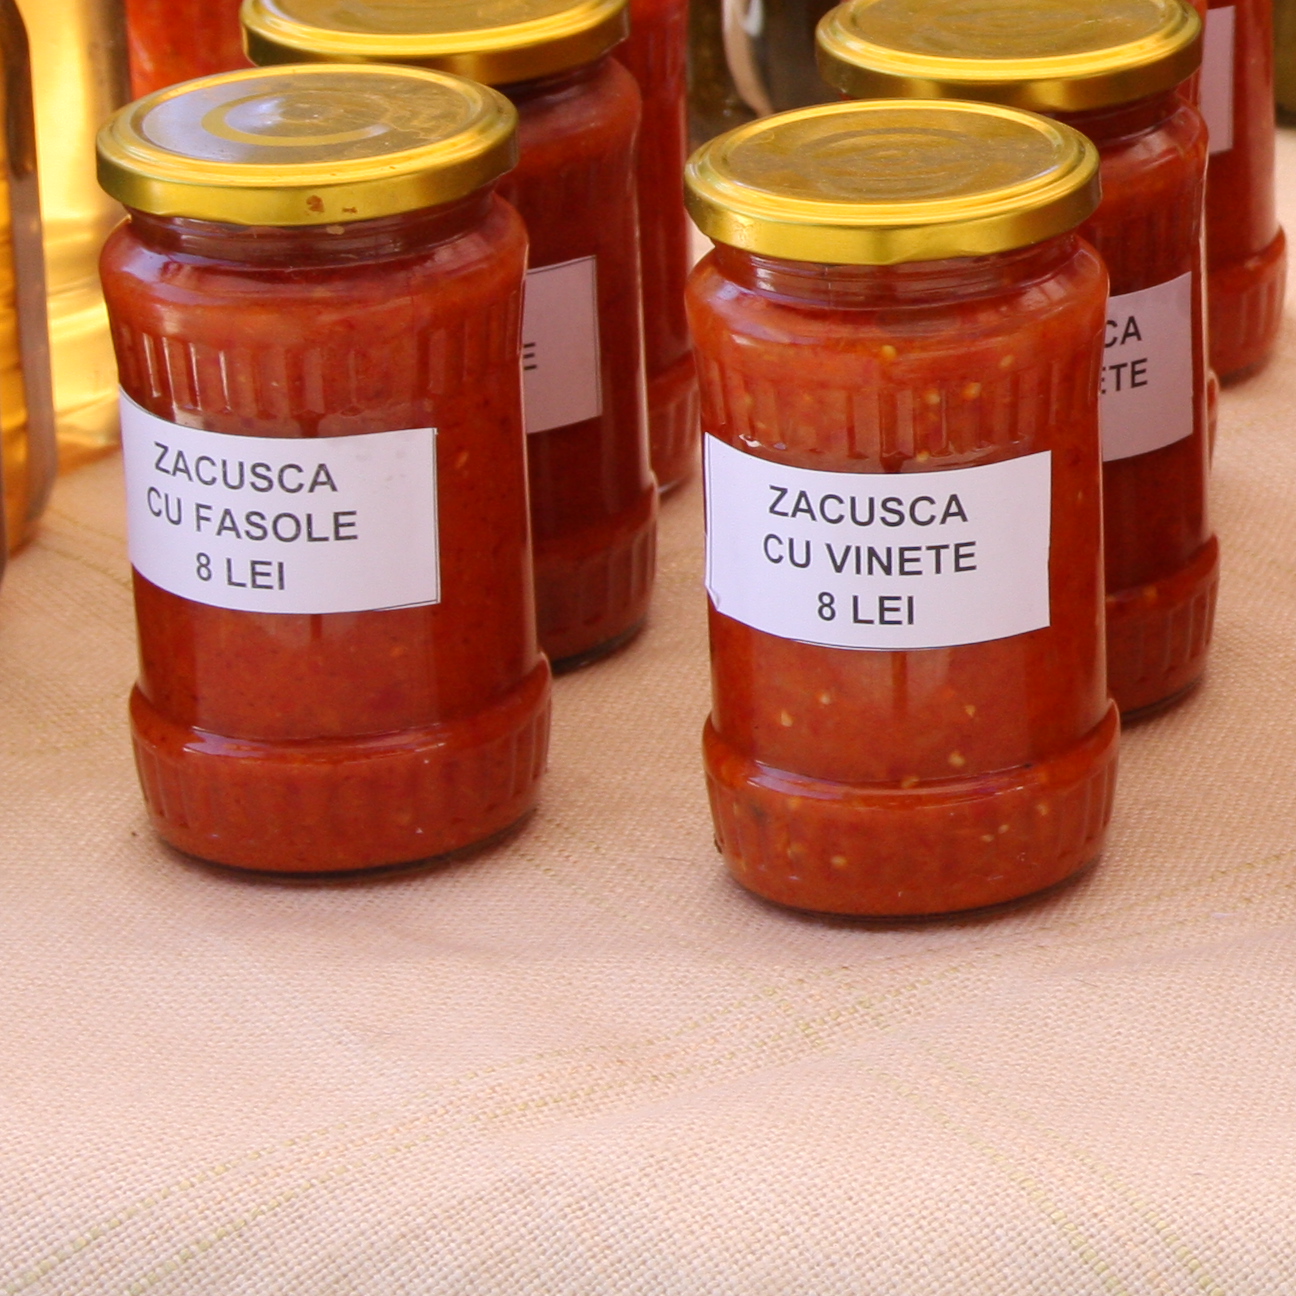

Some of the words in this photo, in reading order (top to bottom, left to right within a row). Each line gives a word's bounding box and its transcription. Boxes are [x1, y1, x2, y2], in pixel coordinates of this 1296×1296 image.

[154, 441, 338, 494] ZACUSCA
[147, 486, 183, 526] CU
[194, 502, 359, 543] FASOLE
[768, 484, 969, 527] ZACUSCA
[196, 552, 213, 582] 8
[226, 557, 286, 591] LEI
[763, 533, 811, 569] CU
[825, 540, 978, 577] VINETE
[817, 591, 836, 622] 8
[851, 594, 915, 626] LEI
